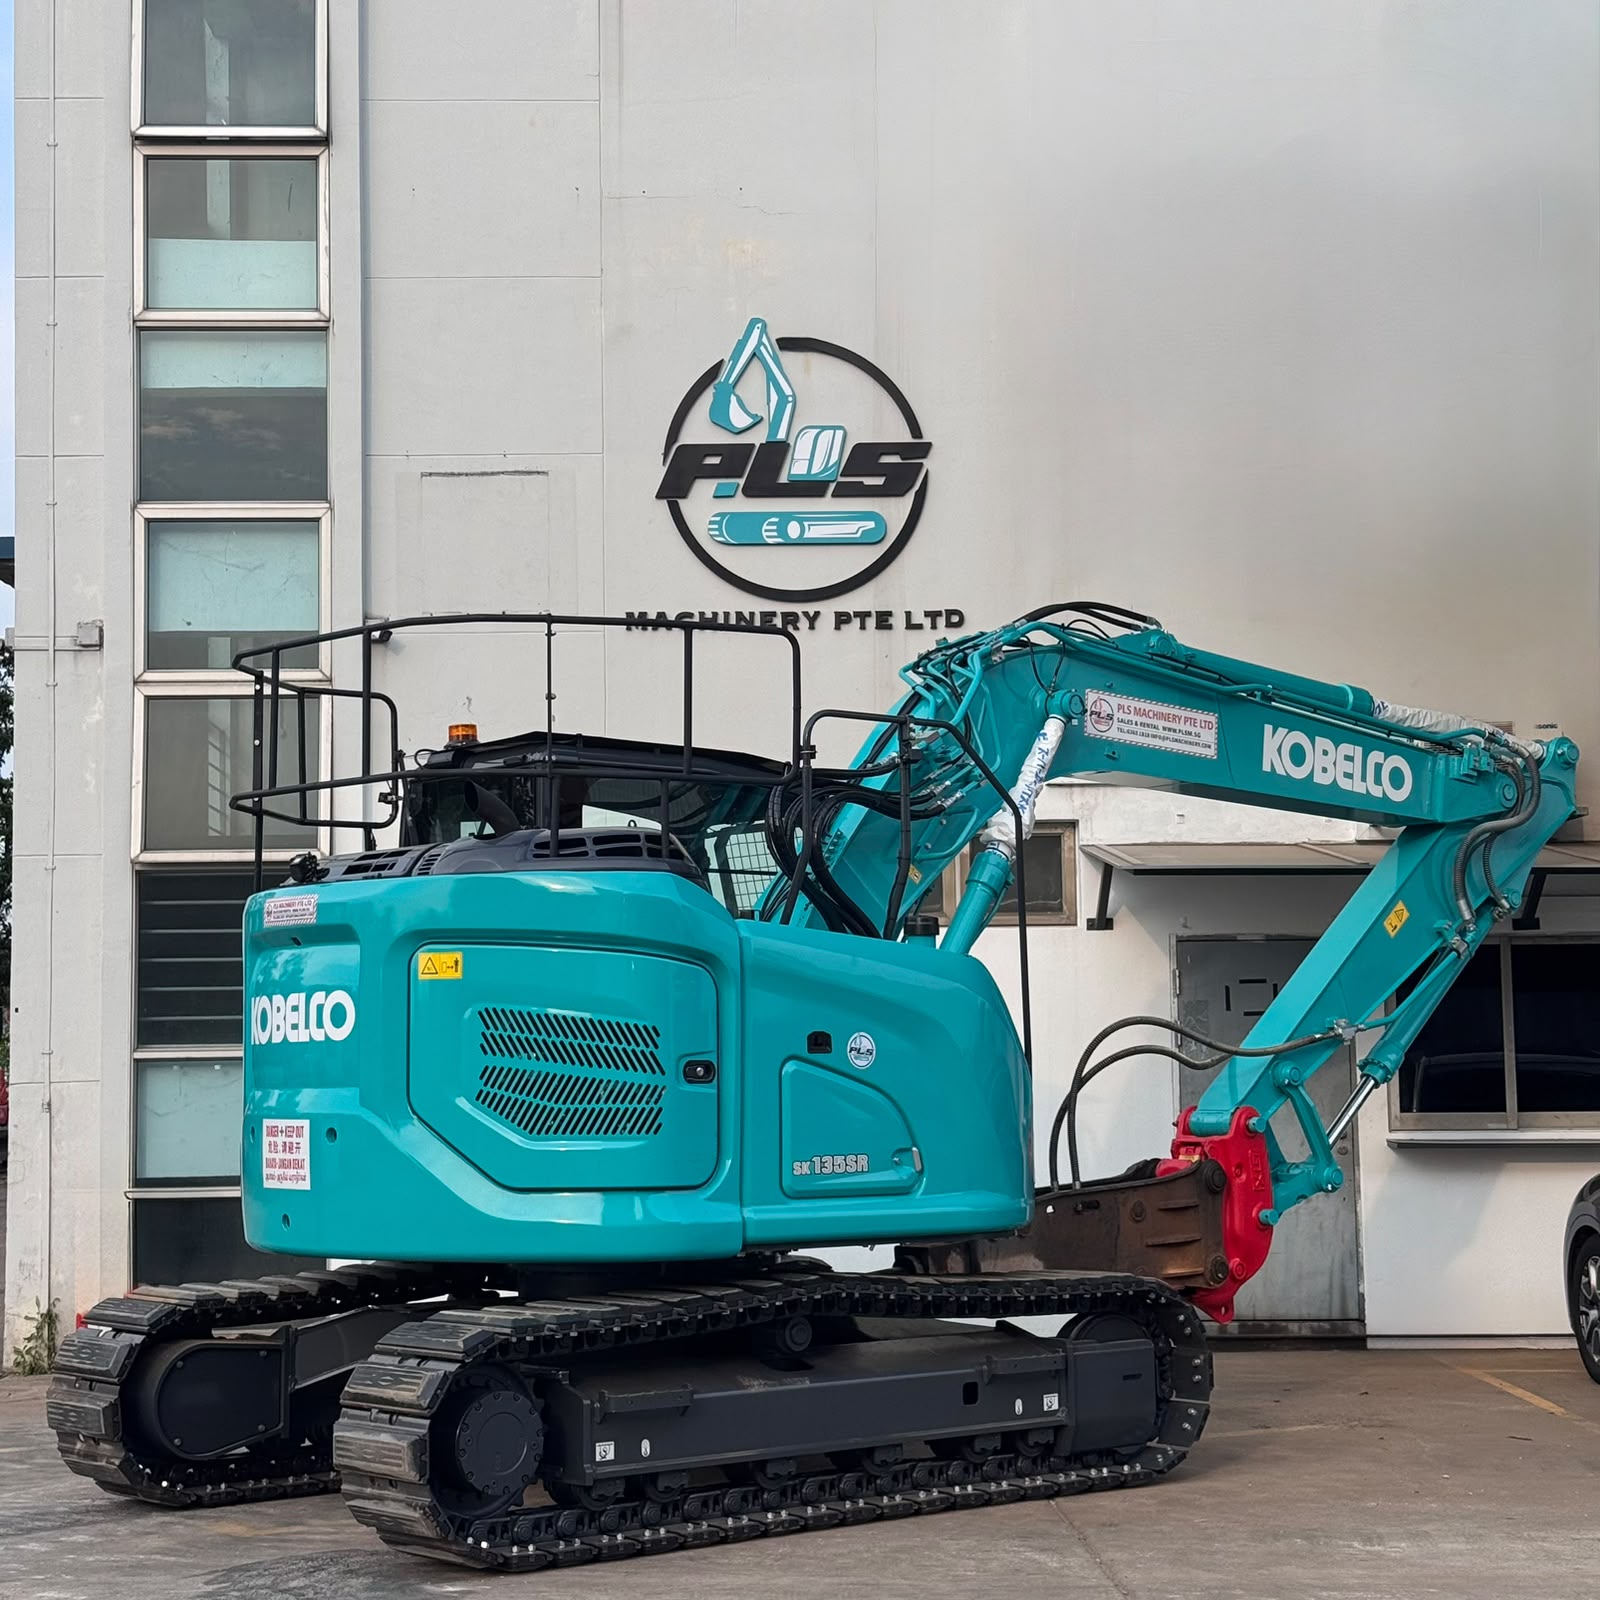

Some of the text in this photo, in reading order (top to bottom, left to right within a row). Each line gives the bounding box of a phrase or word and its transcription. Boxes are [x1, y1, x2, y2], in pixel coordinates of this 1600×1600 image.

[833, 610, 894, 631] PTE
[904, 608, 965, 631] LTD
[1089, 710, 1114, 721] PLS
[1117, 703, 1214, 731] PLS MACHINERY PTE LTD
[1262, 723, 1413, 803] KOBELCO
[250, 989, 356, 1045] KOBELCO
[849, 1046, 874, 1056] PLS
